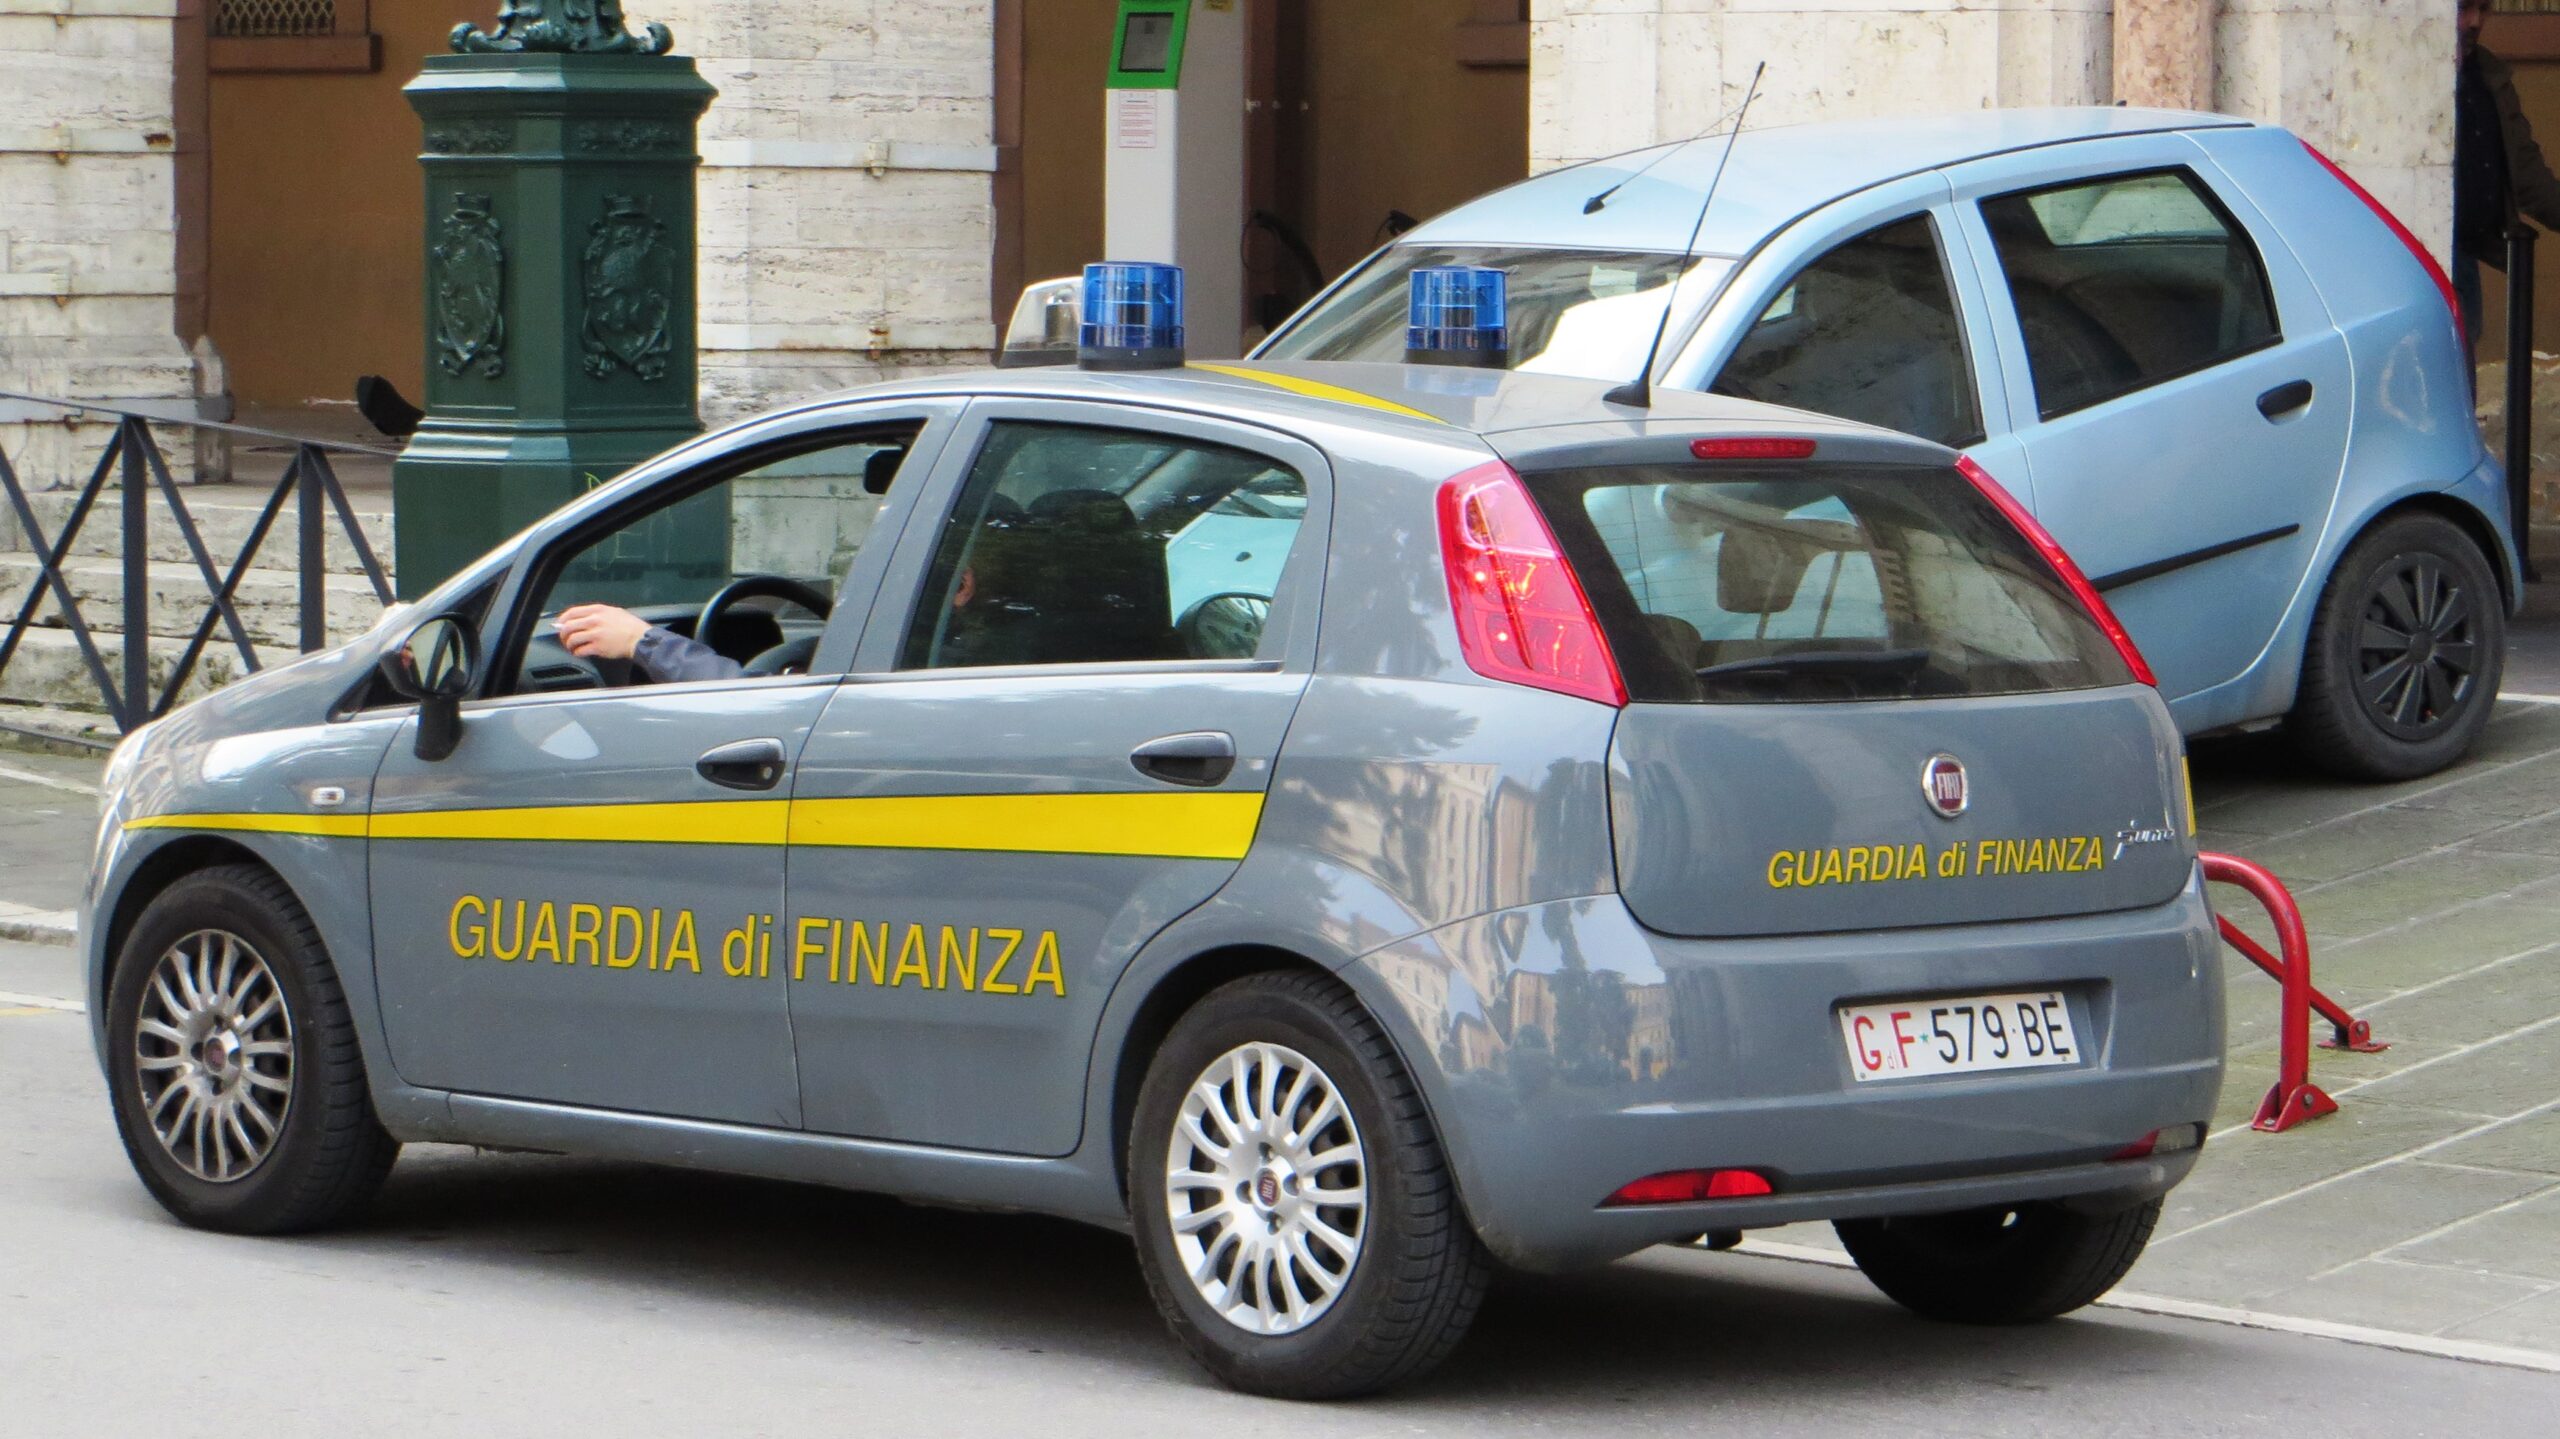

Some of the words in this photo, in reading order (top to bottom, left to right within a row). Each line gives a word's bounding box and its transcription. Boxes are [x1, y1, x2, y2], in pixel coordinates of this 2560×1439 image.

[1935, 771, 1963, 800] FIAT
[1767, 843, 1928, 888] GUARDIA
[1937, 841, 1968, 878] di
[1975, 836, 2104, 876] FINANZA
[448, 895, 701, 973] GUARDIA
[721, 914, 772, 979] di
[793, 916, 1067, 997] FINANZA
